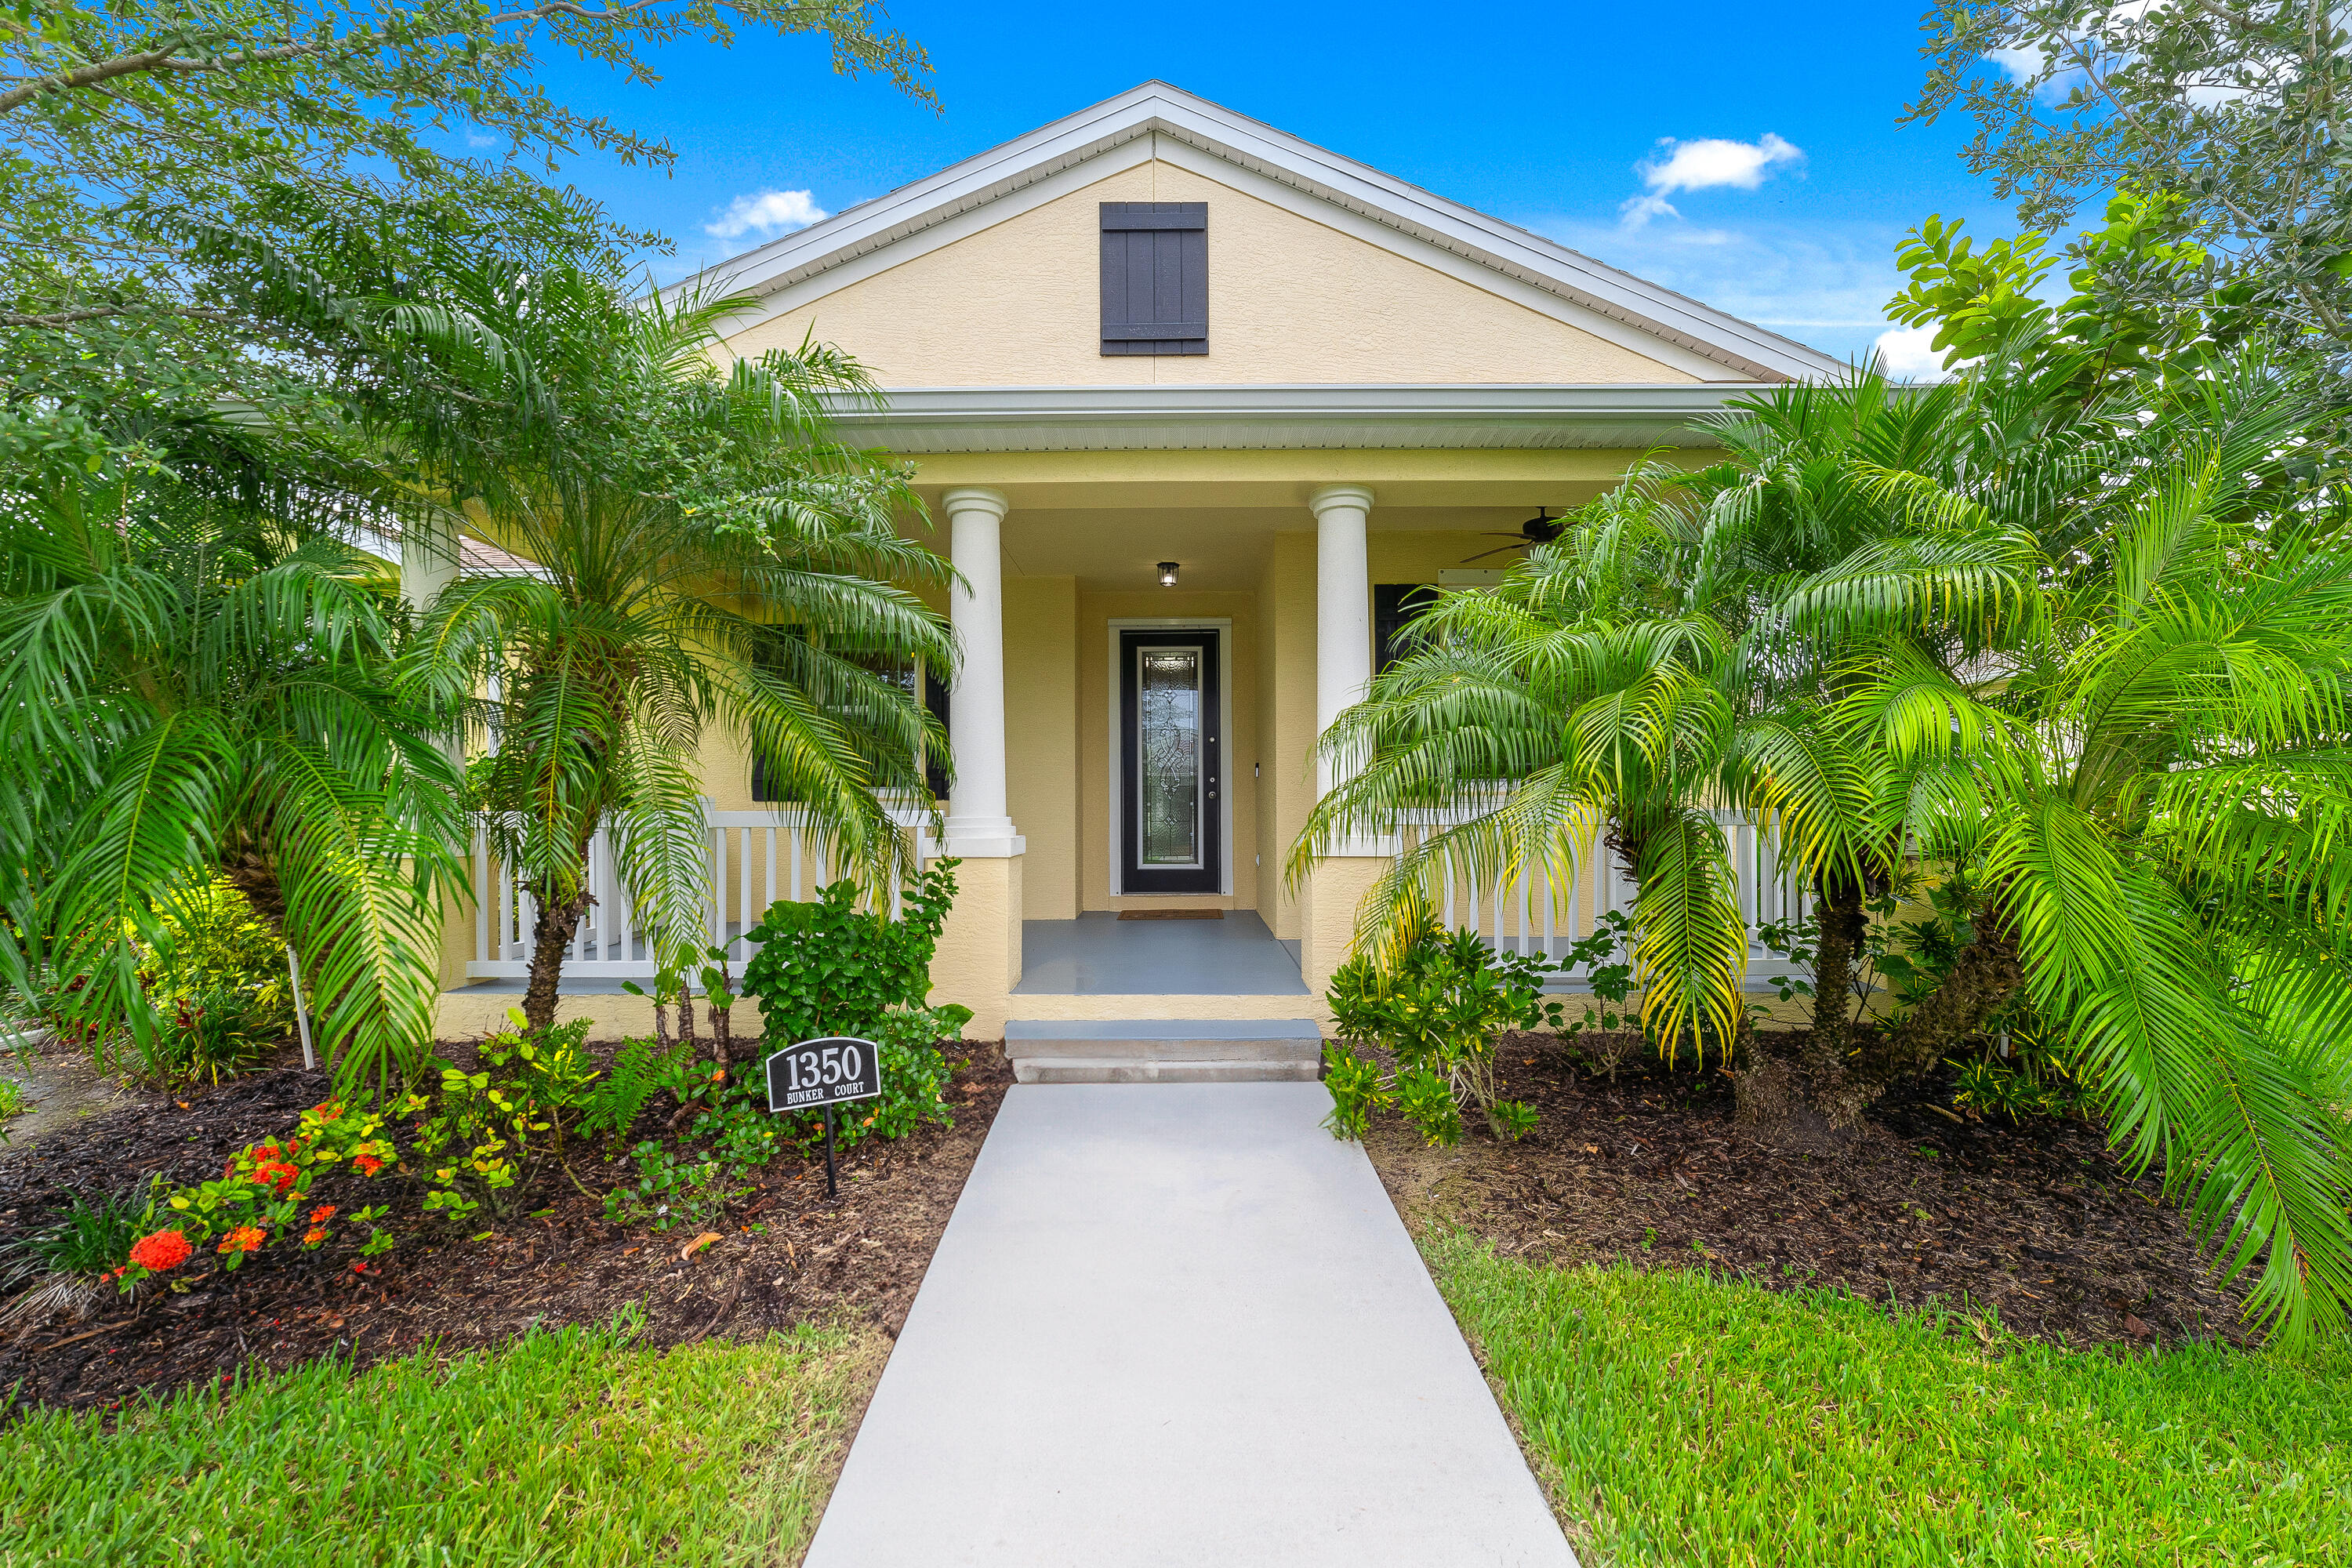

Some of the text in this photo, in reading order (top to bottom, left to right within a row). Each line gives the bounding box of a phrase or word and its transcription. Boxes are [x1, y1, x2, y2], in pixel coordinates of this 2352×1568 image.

[786, 1046, 862, 1091] 1350
[786, 1081, 864, 1105] BUNKER COURT
